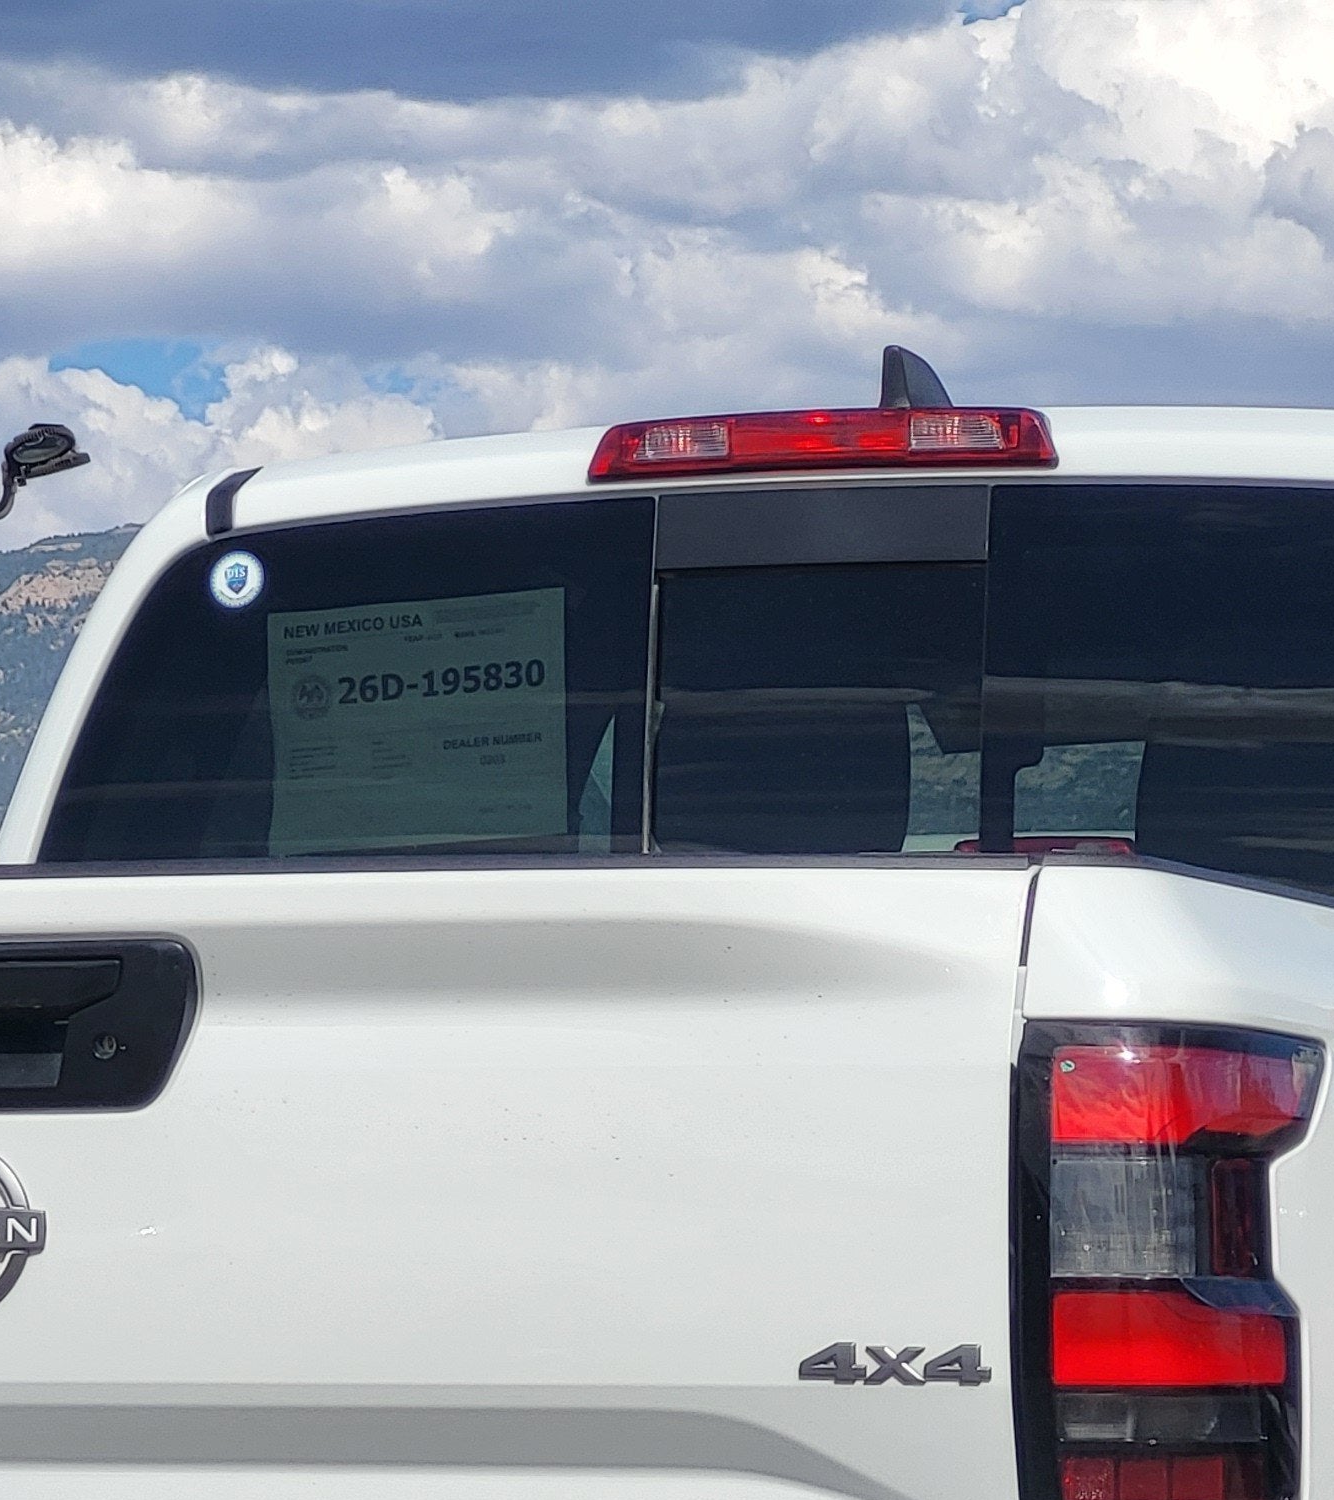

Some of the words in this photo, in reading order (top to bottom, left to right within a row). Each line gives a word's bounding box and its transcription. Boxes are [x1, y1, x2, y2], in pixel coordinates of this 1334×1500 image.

[283, 624, 320, 639] NEW
[323, 616, 385, 635] MEXICO
[390, 613, 423, 629] USA
[337, 658, 546, 705] 26D-195830
[442, 736, 490, 750] DEALER
[492, 732, 543, 746] NUMBER
